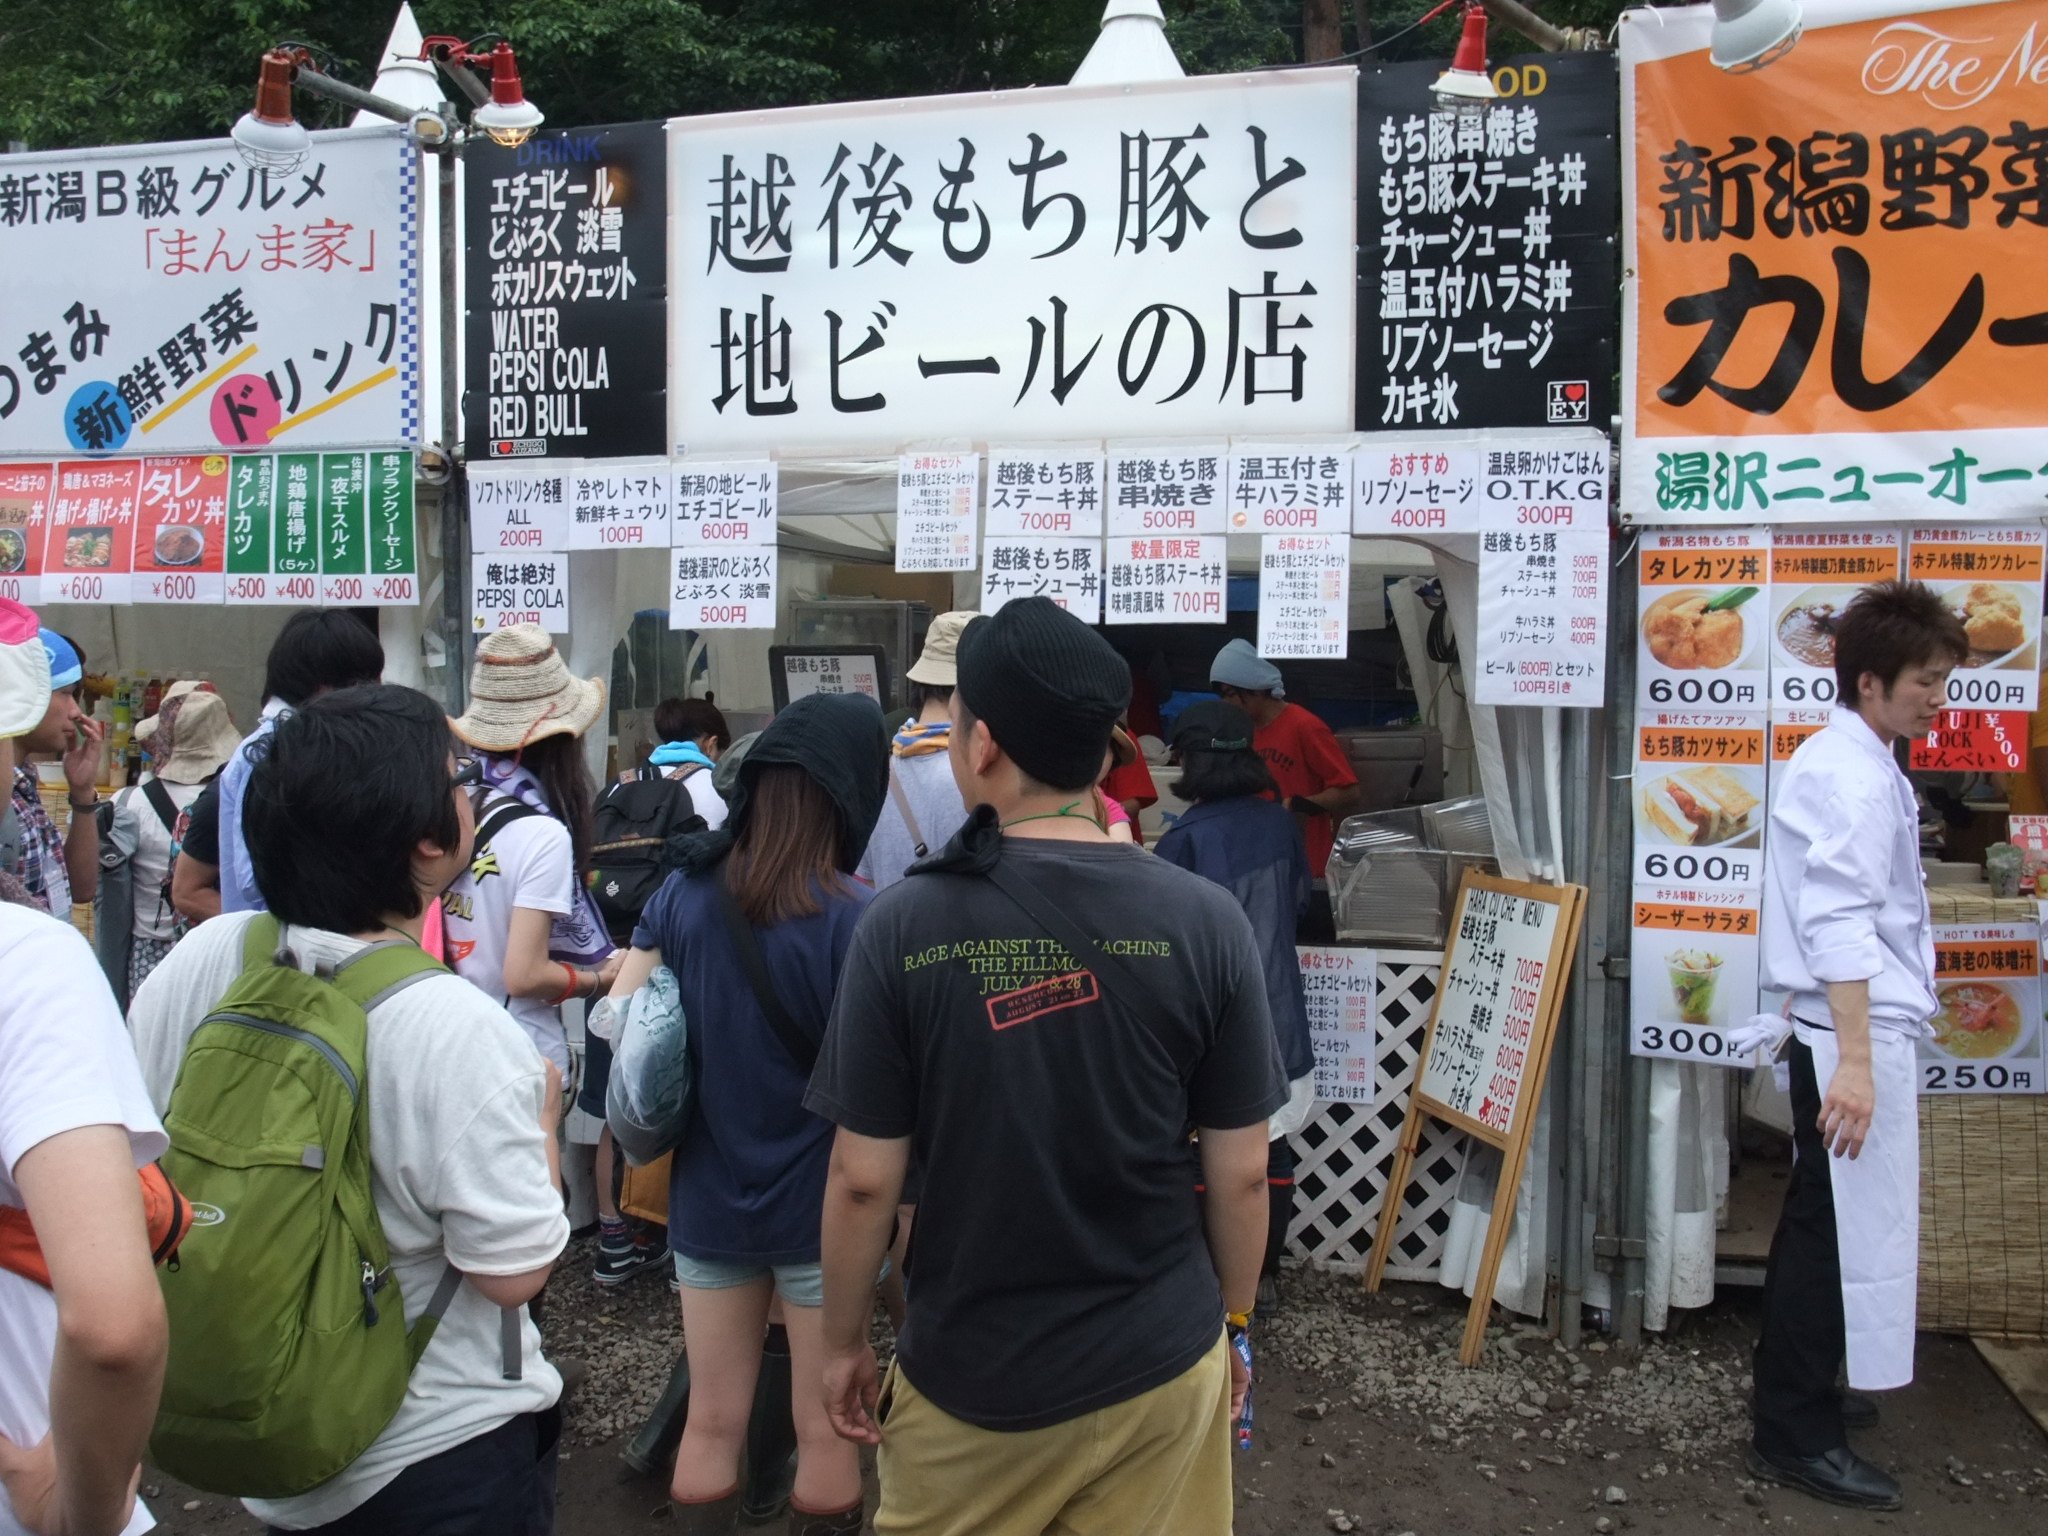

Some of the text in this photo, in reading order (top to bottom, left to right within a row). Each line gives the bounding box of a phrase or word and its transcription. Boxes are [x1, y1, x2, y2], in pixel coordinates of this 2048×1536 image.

[1861, 22, 1993, 95] The
[517, 137, 600, 166] DRINK
[0, 163, 327, 227] 新潟B級グルメ
[490, 167, 614, 215] エチゴビール
[1379, 152, 1587, 216] もち豚ステーキ丼
[706, 124, 1307, 277] 越後もち豚と
[489, 207, 623, 260] どぶろく 淡雪
[1380, 206, 1551, 266] チャーシュー丼
[491, 256, 637, 306] ポカリスウェット
[1379, 260, 1572, 319] 温玉付ハラミ丼
[491, 307, 559, 351] WATER
[710, 271, 1318, 416] 地ビールの店
[1382, 318, 1554, 373] リブソーセージ
[74, 288, 258, 450] 新鮮野菜
[223, 302, 397, 443] ドリンク
[489, 347, 609, 393] PEPSI COLA
[1382, 372, 1459, 424] カキ氷
[489, 393, 588, 438] RED BULL
[351, 456, 362, 493] 佐渡沖
[914, 457, 962, 470] お得なセット
[998, 461, 1094, 485] 越後もち豚
[1117, 457, 1217, 484] 越後もち豚
[1239, 456, 1339, 481] 温玉付き
[1389, 453, 1449, 476] おすすめ
[1488, 452, 1605, 476] 温泉卵かけごはん
[143, 467, 201, 506] タレ
[577, 476, 662, 501] 冷やしトマト
[680, 473, 770, 497] 新潟の地ビール
[1656, 447, 2048, 511] 湯沢ニューオー
[475, 478, 563, 505] ソフトドリンク各種
[992, 487, 1098, 510] ステーキ丼
[1118, 484, 1215, 508] 串焼き
[1236, 483, 1344, 508] 牛ハラミ丼
[1362, 478, 1473, 505] リブソーセージ
[162, 495, 225, 524] カツ丼
[234, 465, 254, 555] タレカツ
[287, 464, 307, 554] 地鶏唐揚げ
[331, 465, 350, 559] 一夜干スルメ
[382, 455, 402, 571] 串フランクソーセージ
[507, 509, 531, 525] ALL
[575, 503, 667, 523] 新鮮キュウリ
[677, 498, 772, 521] エチゴビール
[1143, 511, 1195, 528] 500円
[1264, 509, 1317, 527] 600円
[1391, 509, 1445, 527] 400円
[1517, 506, 1573, 525] 300円
[701, 523, 748, 540] 600円
[1021, 513, 1071, 531] 700円
[500, 529, 542, 547] 200円
[599, 526, 643, 543] 100円
[1278, 538, 1330, 550] お得なセット
[1484, 533, 1557, 552] 越後もち豚
[1659, 536, 1749, 548] 新潟名物もち豚
[1773, 534, 1895, 545] 新潟県産夏野菜を使った
[992, 547, 1091, 571] 越後もち豚
[1131, 540, 1200, 560] 数量限定
[1526, 555, 1598, 568] 串焼き 500円
[1912, 553, 2039, 571] ホテル特製カツカレー
[487, 563, 555, 586] 俺は絶対
[678, 555, 770, 580] 越後湯沢のどぶろく
[1112, 563, 1221, 587] 越後もち豚ステーキ丼
[1518, 571, 1597, 583] ステーキ丼 700円
[1649, 557, 1760, 581] タレカツ丼
[60, 575, 102, 600] ¥600
[153, 575, 195, 600] ¥600
[228, 578, 265, 598] ¥500
[276, 578, 314, 598] ¥400
[325, 579, 362, 599] ¥300
[373, 578, 412, 599] ¥200
[676, 583, 770, 600] どぶろく 淡雪
[986, 573, 1098, 597] チャーシュー丼
[1501, 586, 1597, 599] チャーシュー丼 700円
[477, 588, 564, 608] PEPSI COLA
[1112, 591, 1220, 614] 味噌漬風味 700円
[700, 606, 746, 623] 500円
[1515, 616, 1596, 630] 牛ハラミ丼 600円
[1500, 632, 1595, 645] リブソーセージ 400円
[787, 658, 840, 673] 越後もち豚
[1513, 681, 1572, 694] 100円引き
[1649, 678, 1754, 703] 600円
[1658, 714, 1747, 726] 揚げたてアツアツ
[1939, 712, 1981, 729] FUJI
[1644, 735, 1758, 758] もち豚カツサンド
[1927, 731, 1972, 748] ROCK
[1913, 753, 1996, 767] せんべい
[1645, 854, 1750, 882] 600円
[1468, 889, 1488, 914] HARA
[1522, 900, 1545, 928] MENU
[1656, 889, 1745, 904] ホテル特製ドレッシング
[1460, 914, 1497, 945] 越後もち豚
[1639, 908, 1750, 931] シーザーサラダ
[904, 940, 1170, 972] RAGE AGAINST TH ACHINE
[968, 956, 1088, 974] THE FILLMO
[1298, 953, 1353, 969] 得なセット
[1469, 942, 1543, 988] ステーキ丼 700円
[980, 976, 1025, 994] JULY
[1449, 968, 1536, 1018] チャーシュー丼 700円
[1503, 1014, 1530, 1047] 500円
[1496, 1044, 1523, 1077] 600円
[1430, 1047, 1517, 1106] リブソーセージ 400円
[1925, 1065, 2030, 1089] 250円
